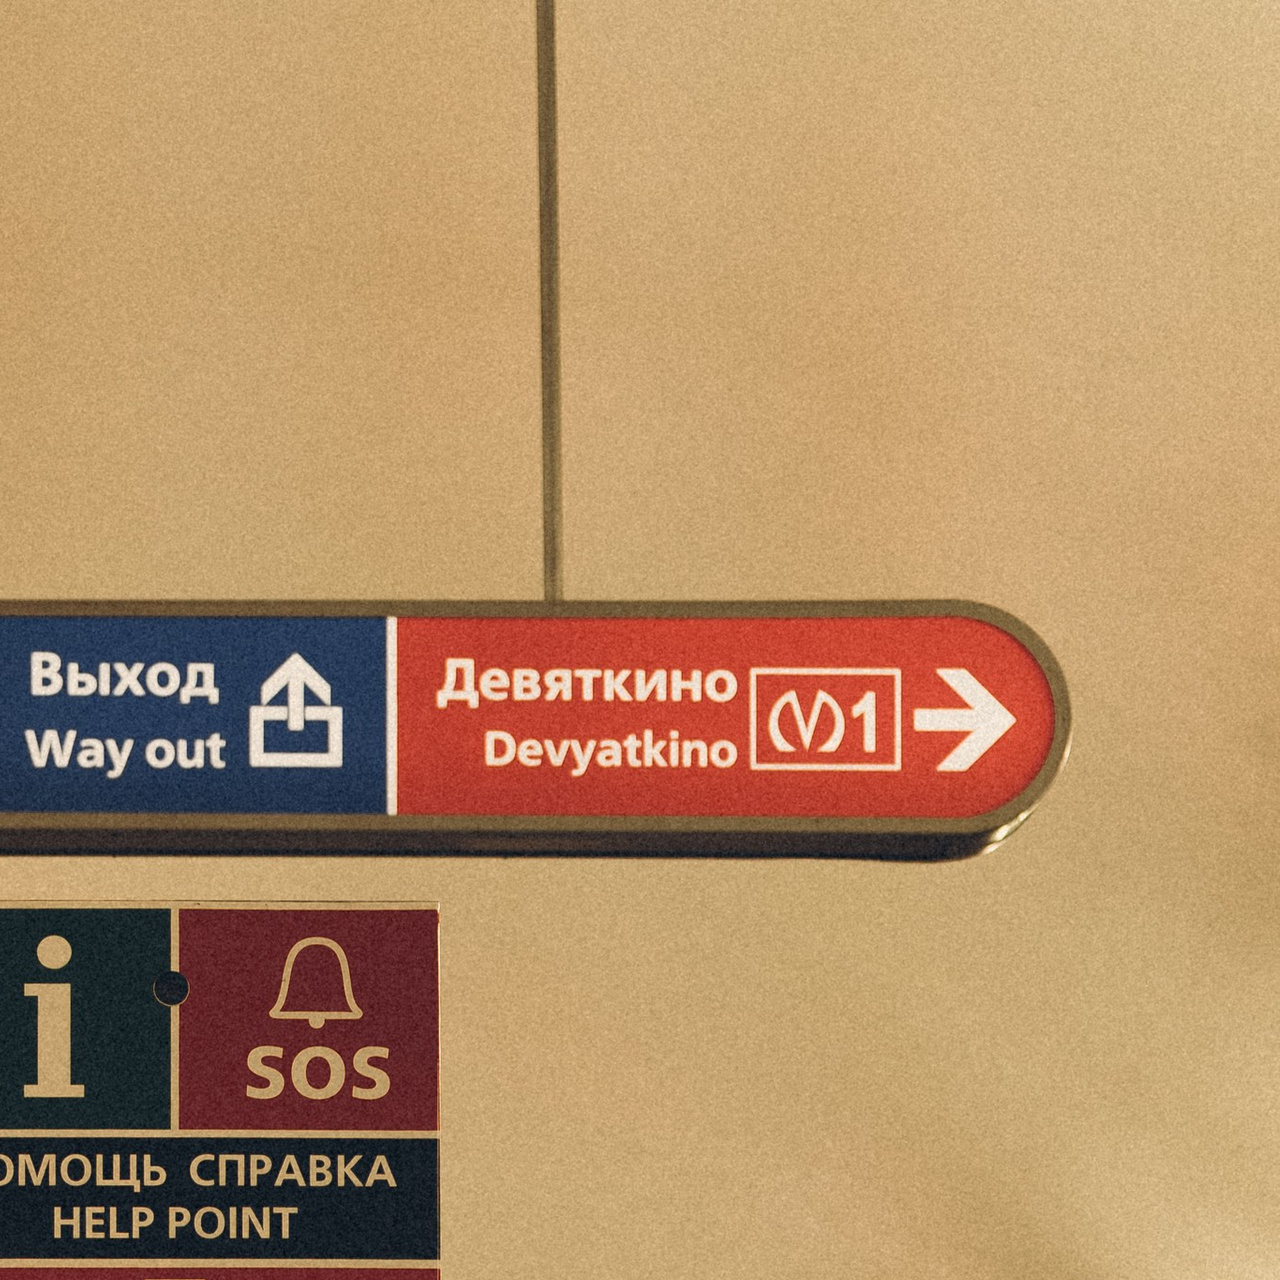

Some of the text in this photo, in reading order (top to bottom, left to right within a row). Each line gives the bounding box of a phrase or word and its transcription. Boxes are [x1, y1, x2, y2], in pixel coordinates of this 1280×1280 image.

[29, 651, 220, 704] Выход
[436, 657, 738, 708] Девяткино
[24, 730, 227, 780] Way out
[483, 728, 738, 778] Devyatkino
[245, 1045, 392, 1101] SOS
[189, 1153, 398, 1188] СПРАВКА
[52, 1206, 299, 1240] HELP POINT
